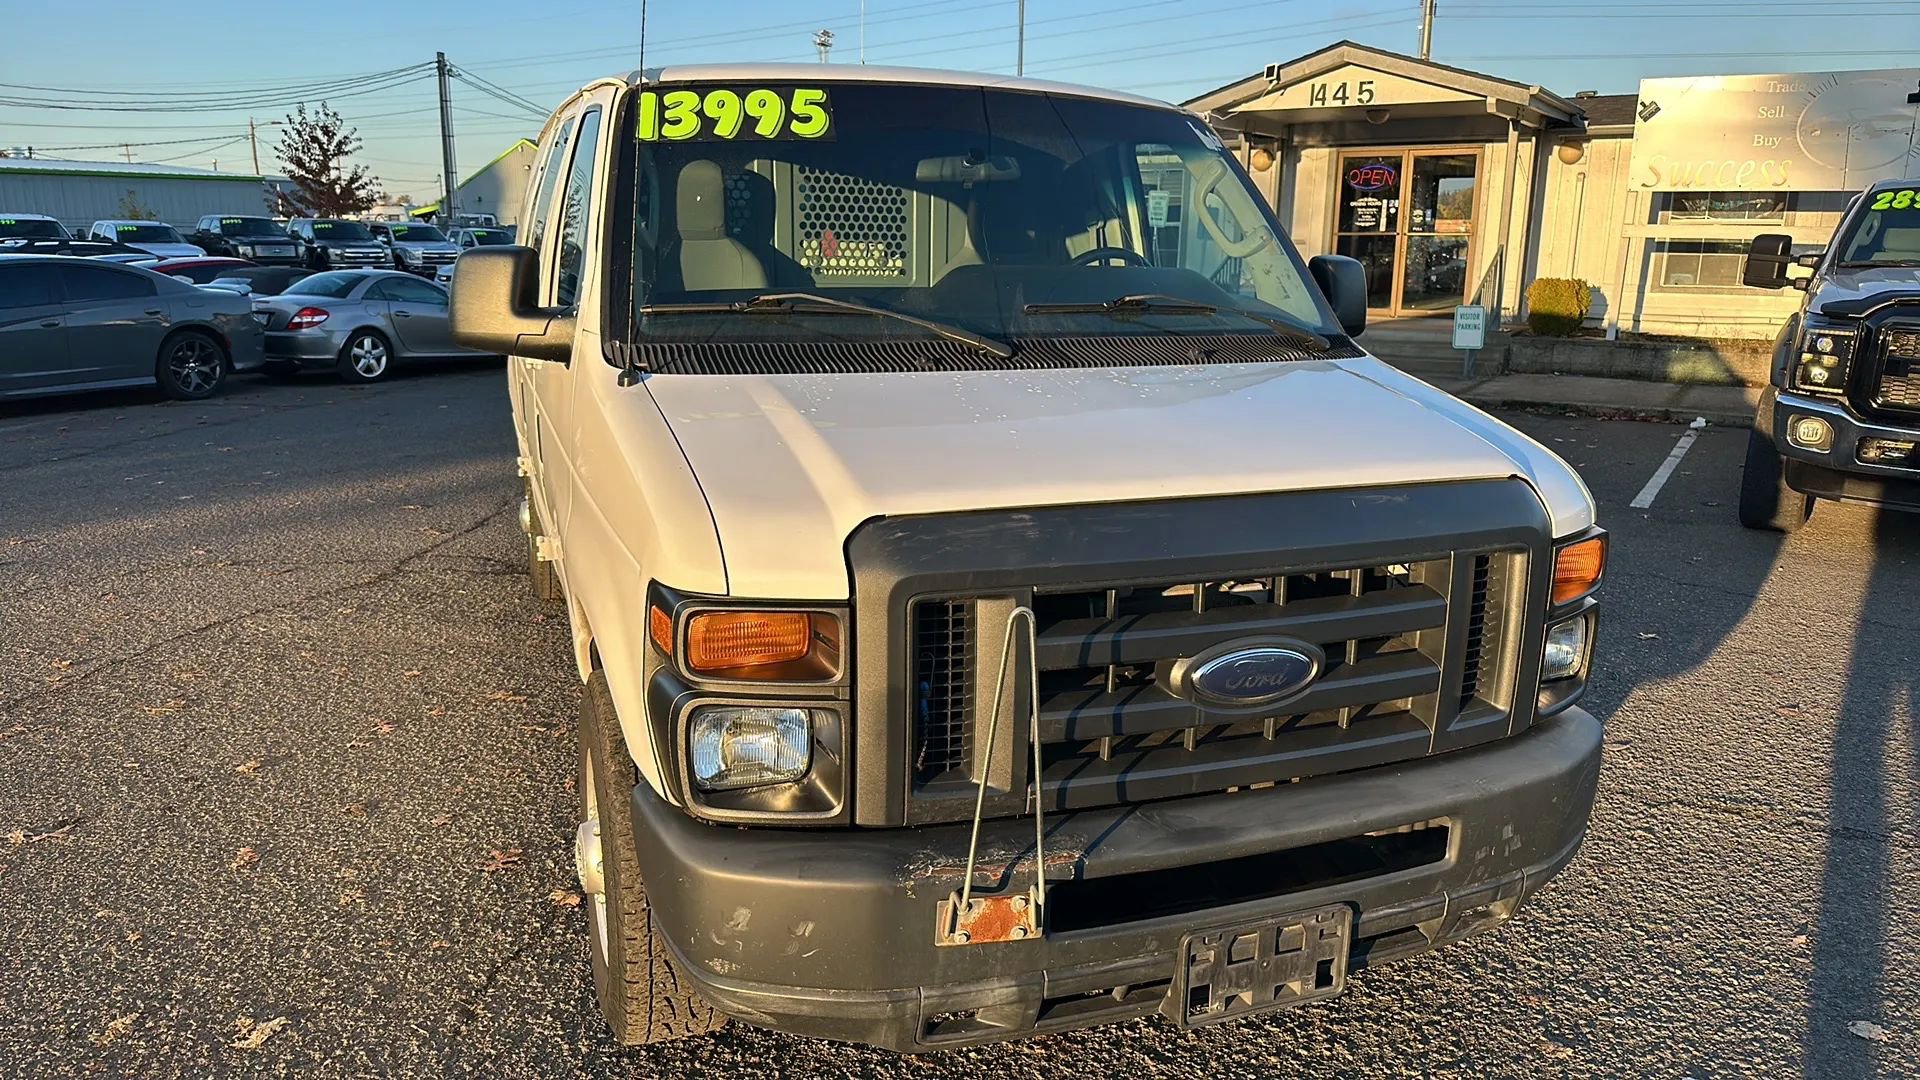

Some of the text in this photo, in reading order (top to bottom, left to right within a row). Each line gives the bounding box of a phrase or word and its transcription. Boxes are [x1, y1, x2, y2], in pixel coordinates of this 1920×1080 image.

[1310, 81, 1374, 106] 1445
[1767, 81, 1806, 93] Trade
[637, 88, 830, 141] 13995
[1758, 105, 1785, 119] Sell
[1752, 134, 1782, 149] Buy
[1349, 169, 1395, 186] OPEN
[1641, 154, 1793, 188] Success
[1871, 190, 1920, 210] 28
[1225, 658, 1290, 690] Ford
